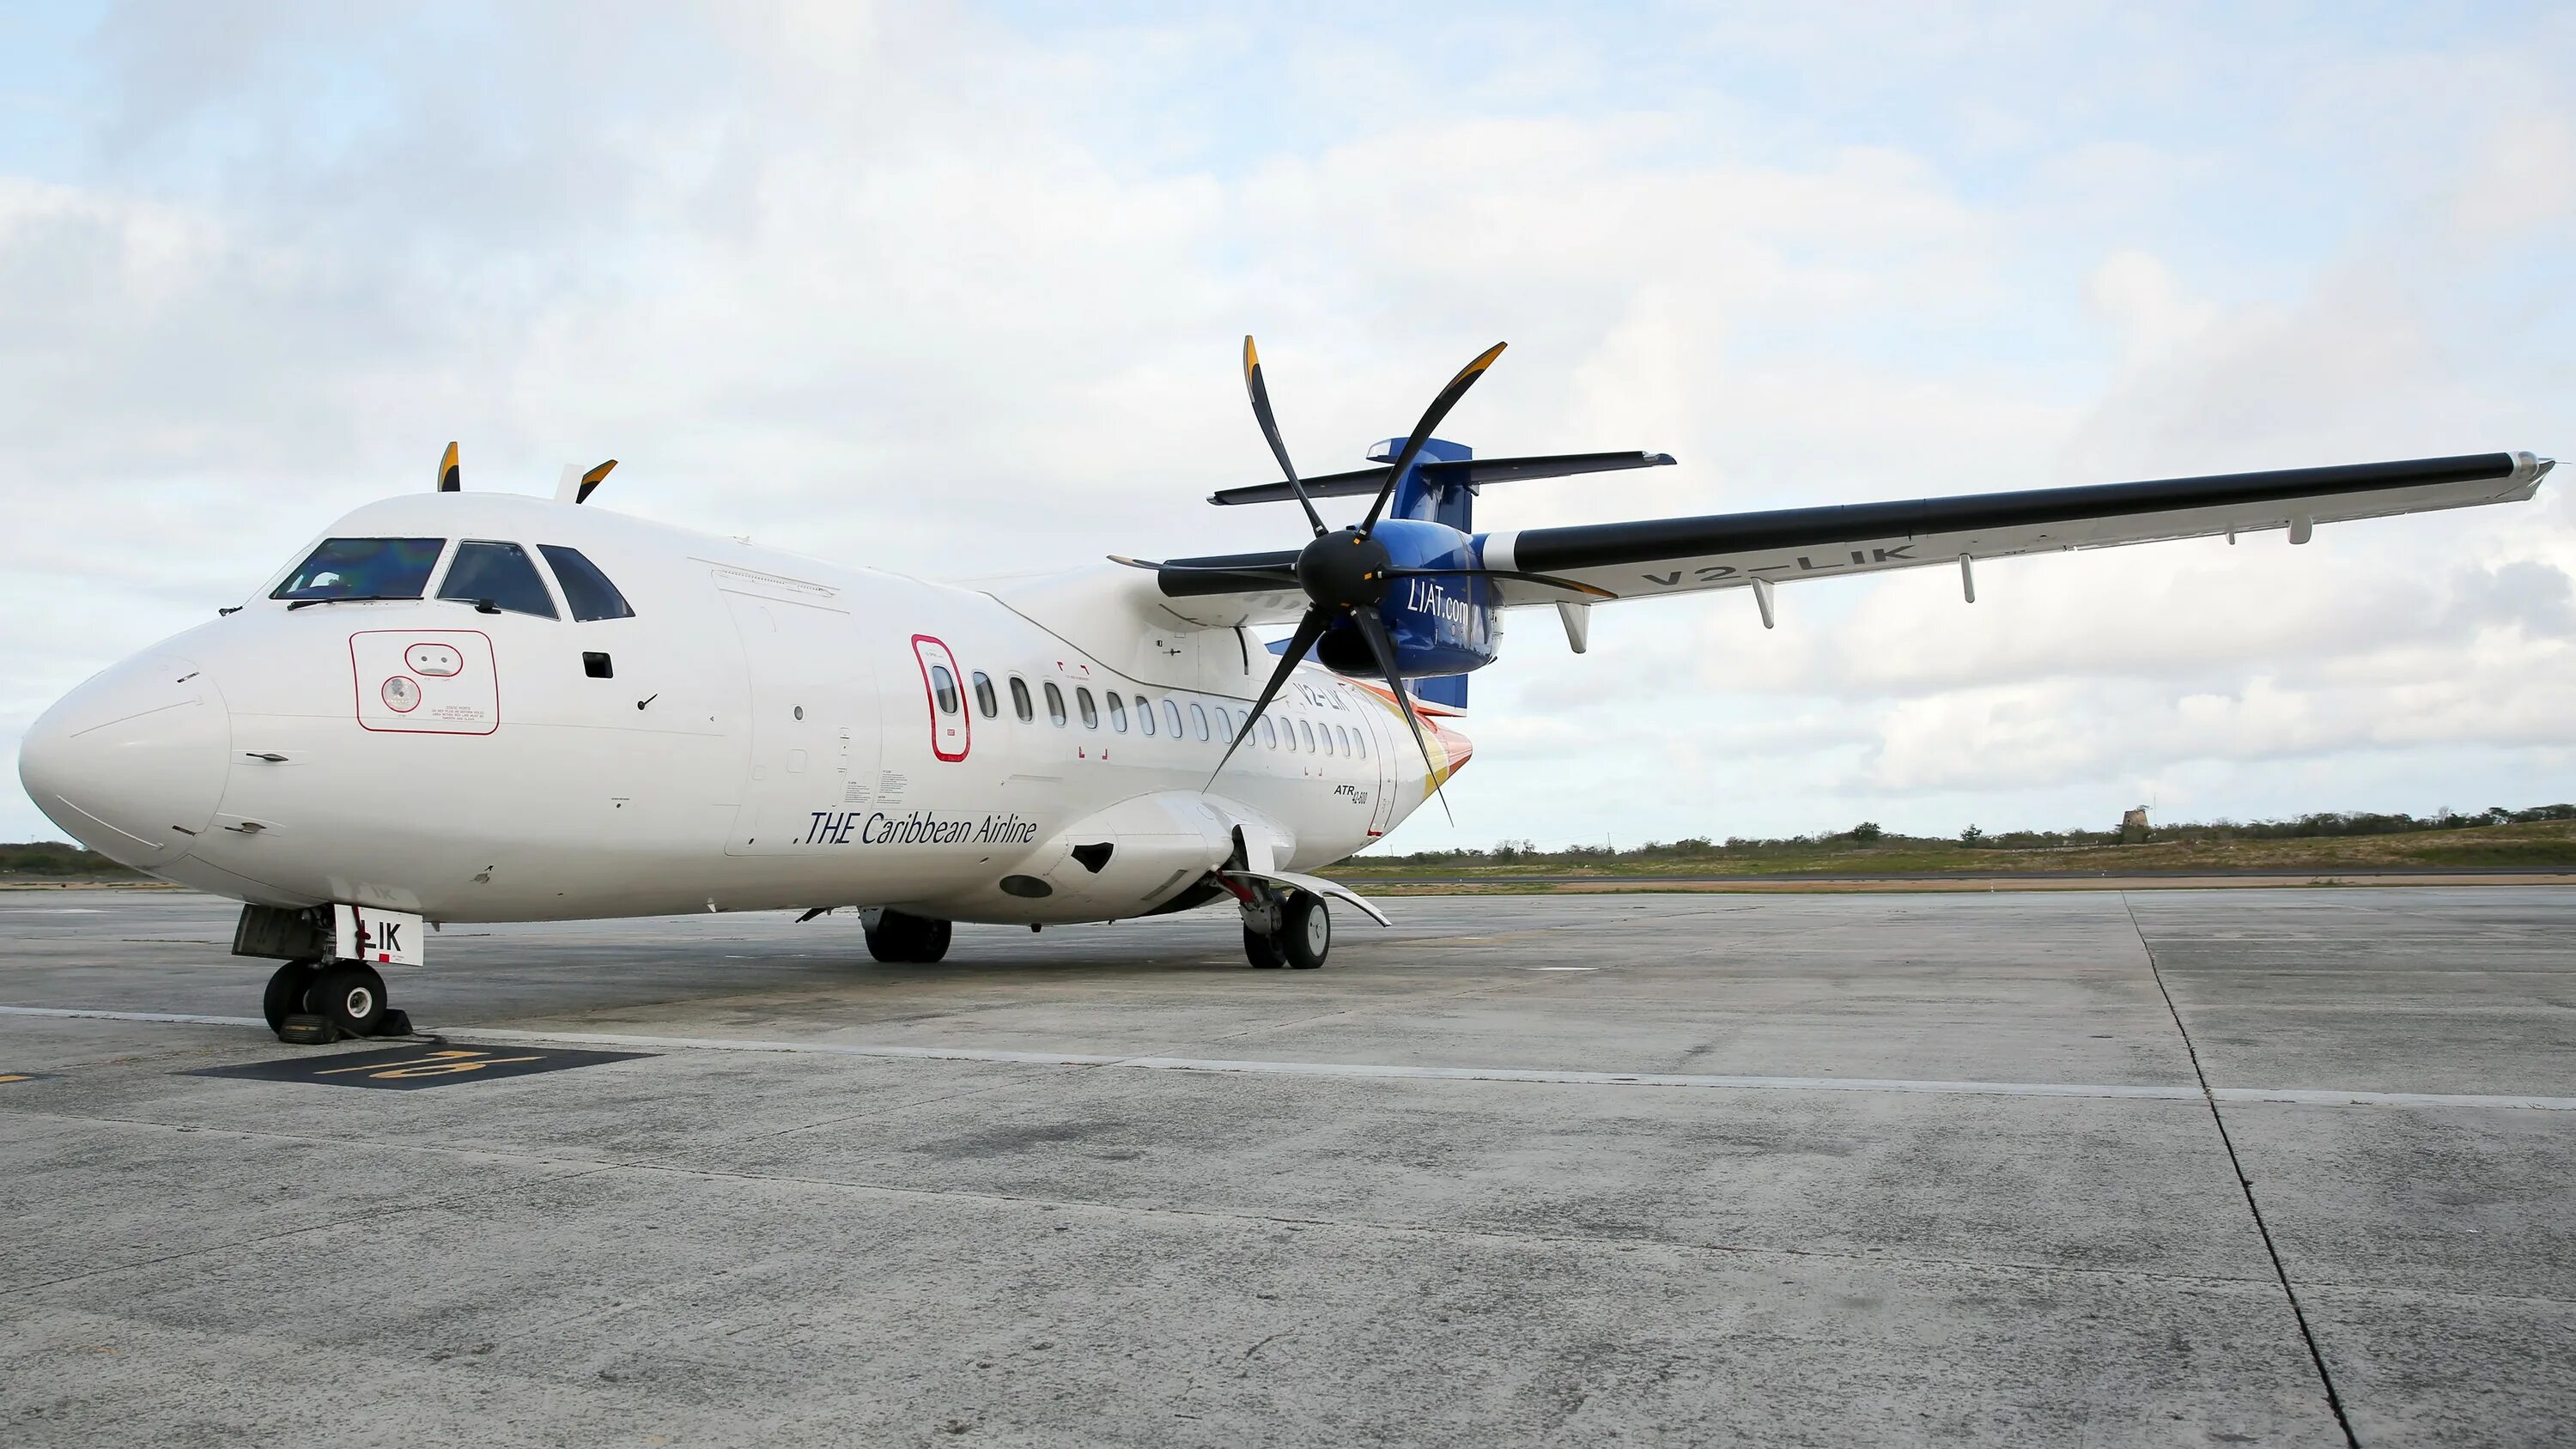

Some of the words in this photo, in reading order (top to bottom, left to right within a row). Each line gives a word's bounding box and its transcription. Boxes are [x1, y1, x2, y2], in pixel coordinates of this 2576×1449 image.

[1641, 544, 1917, 586] V2-LIK
[1407, 579, 1468, 626] LIAT.com
[1292, 682, 1351, 712] V2-LIK
[1334, 785, 1355, 796] ATR
[805, 812, 860, 844] THE
[862, 811, 972, 844] Caribbean
[972, 813, 1037, 844] Airline
